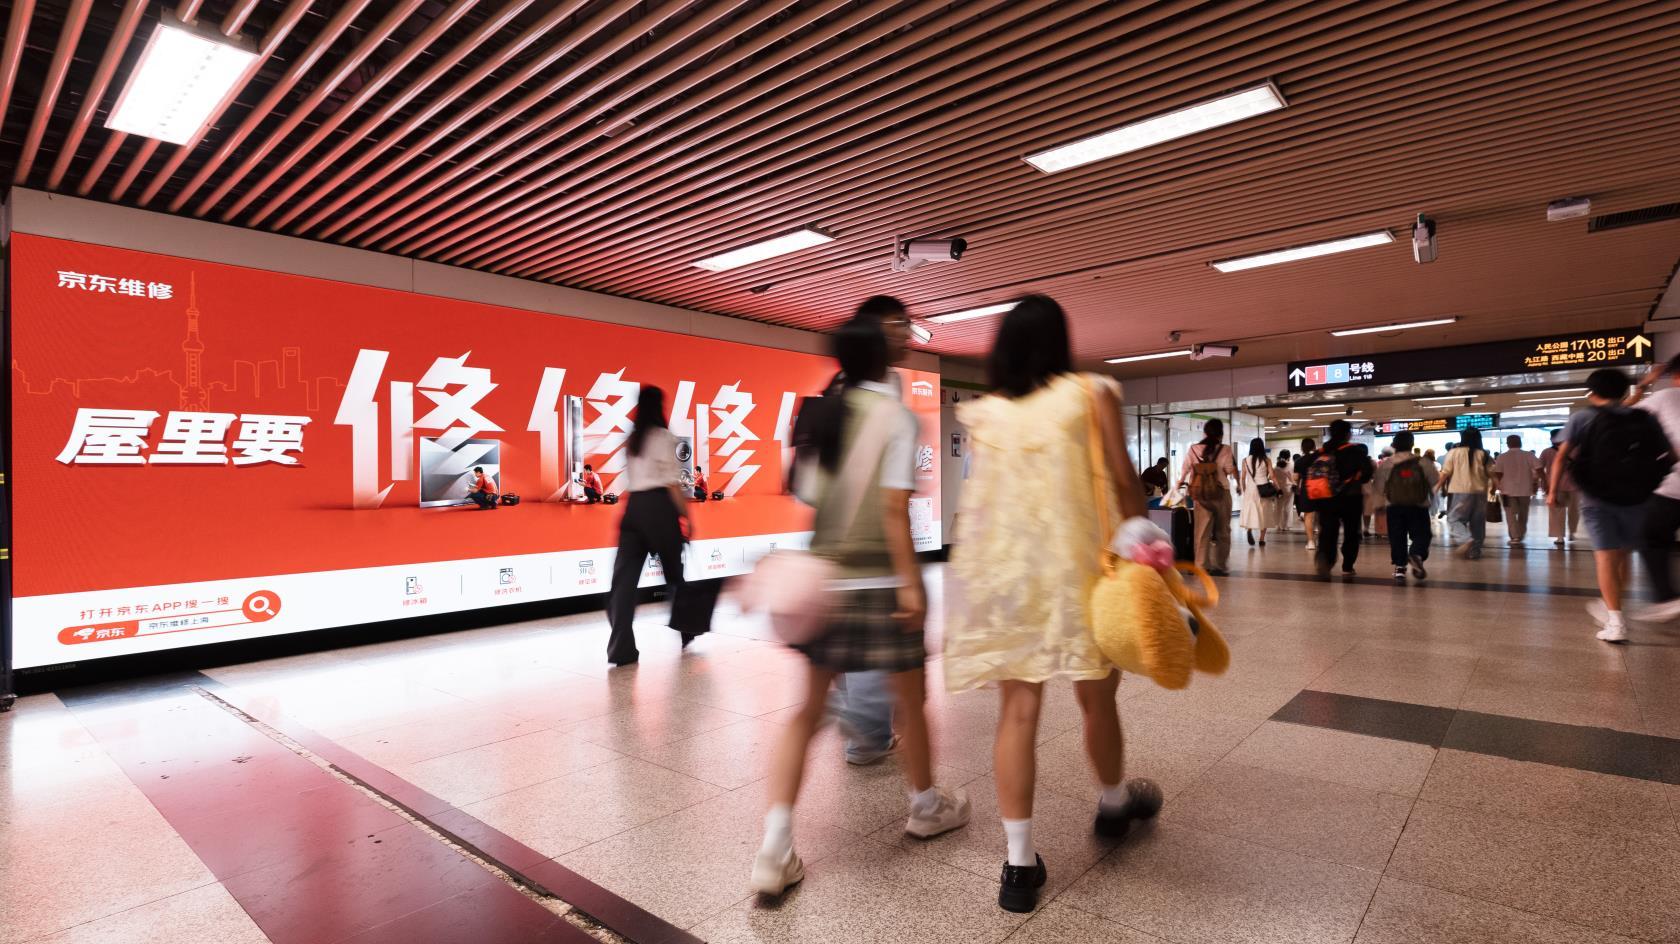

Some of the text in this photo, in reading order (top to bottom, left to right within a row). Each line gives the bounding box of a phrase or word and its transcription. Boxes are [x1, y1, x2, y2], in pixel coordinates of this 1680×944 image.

[57, 270, 174, 300] 京东维修
[1607, 336, 1625, 344] 出口
[1587, 350, 1606, 362] 20
[1607, 348, 1625, 356] 出口
[1313, 361, 1375, 381] 1 8 号线
[55, 407, 312, 466] 屋里要
[334, 349, 506, 509] 修
[79, 596, 230, 621] 打开京东APP搜一搜
[95, 627, 126, 639] 京东
